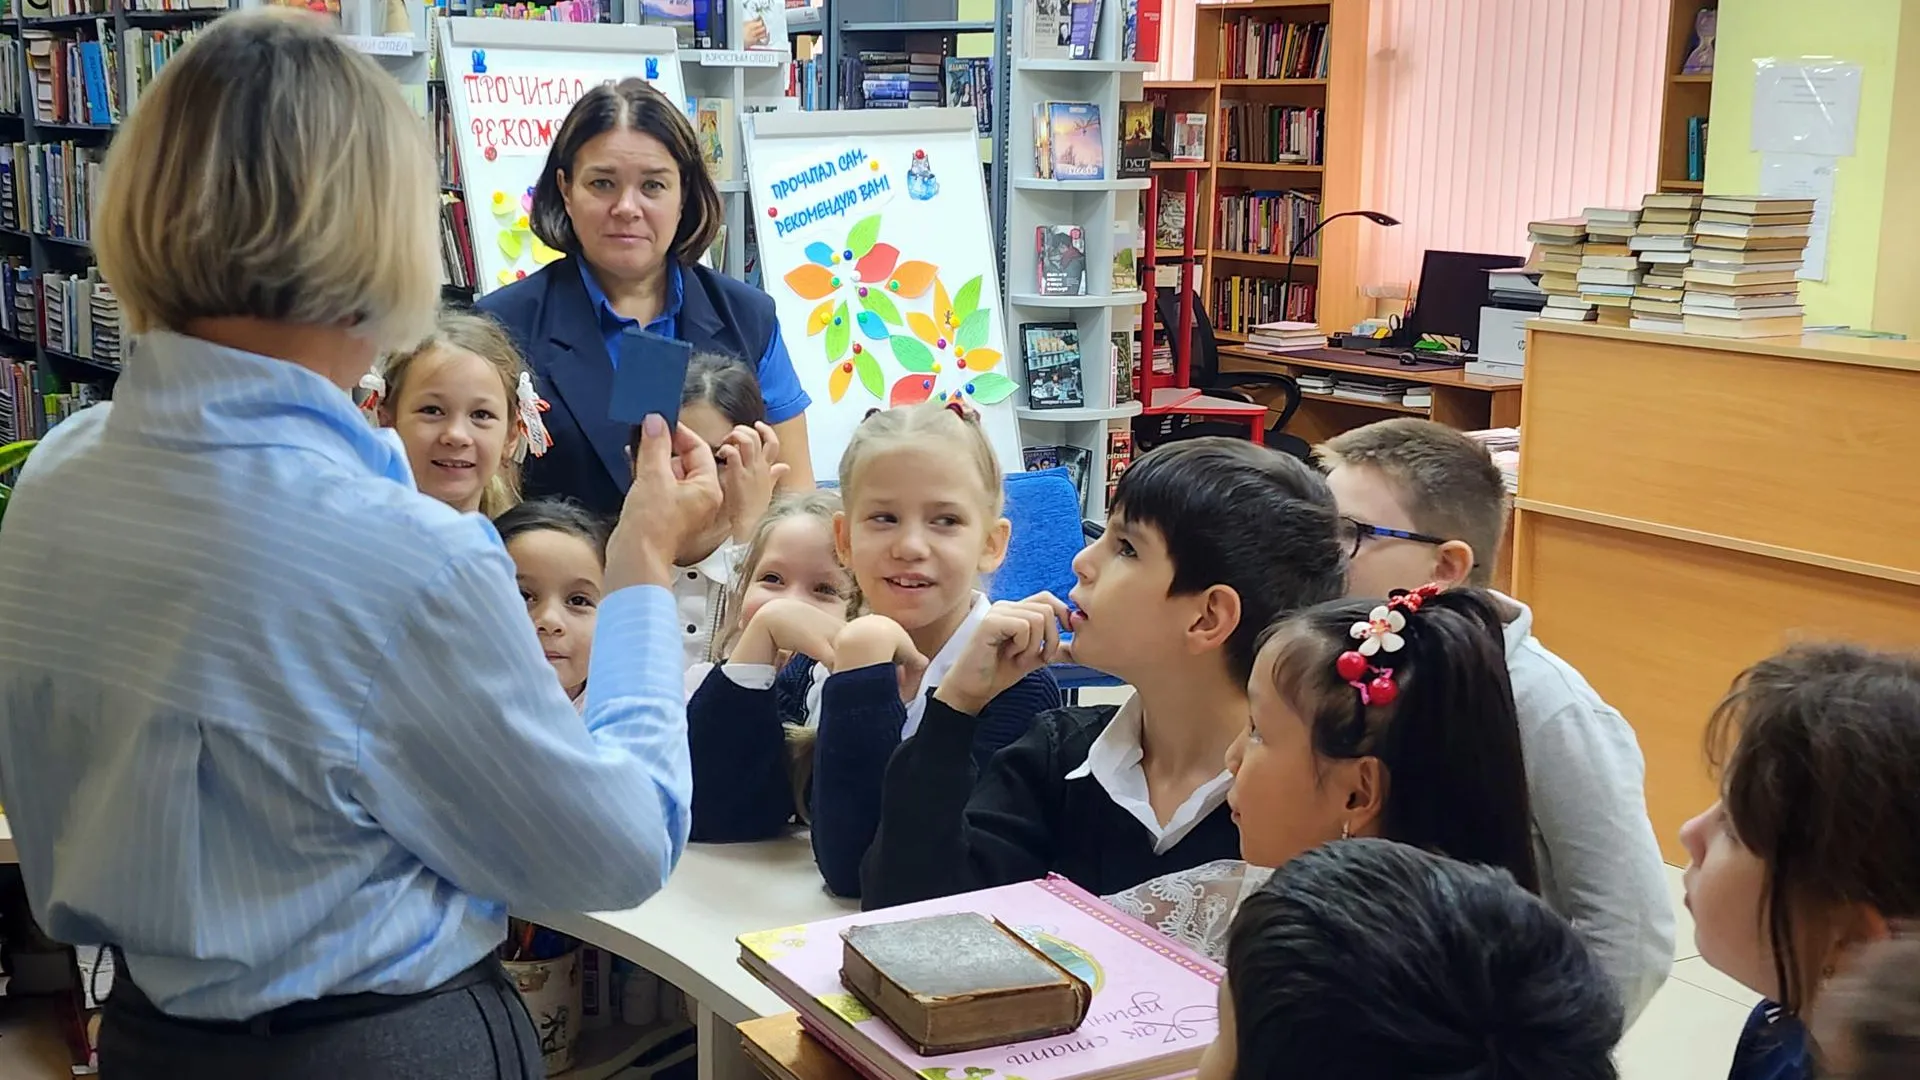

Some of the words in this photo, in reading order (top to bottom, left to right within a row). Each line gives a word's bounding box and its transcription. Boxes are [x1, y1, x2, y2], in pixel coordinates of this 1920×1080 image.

[771, 164, 837, 200] ПРОЧИТАЛ
[774, 189, 857, 238] РЕКОМЕНДУЮ
[859, 174, 890, 201] ВАМ!
[1121, 1004, 1219, 1044] Как
[1006, 1036, 1108, 1067] стать
